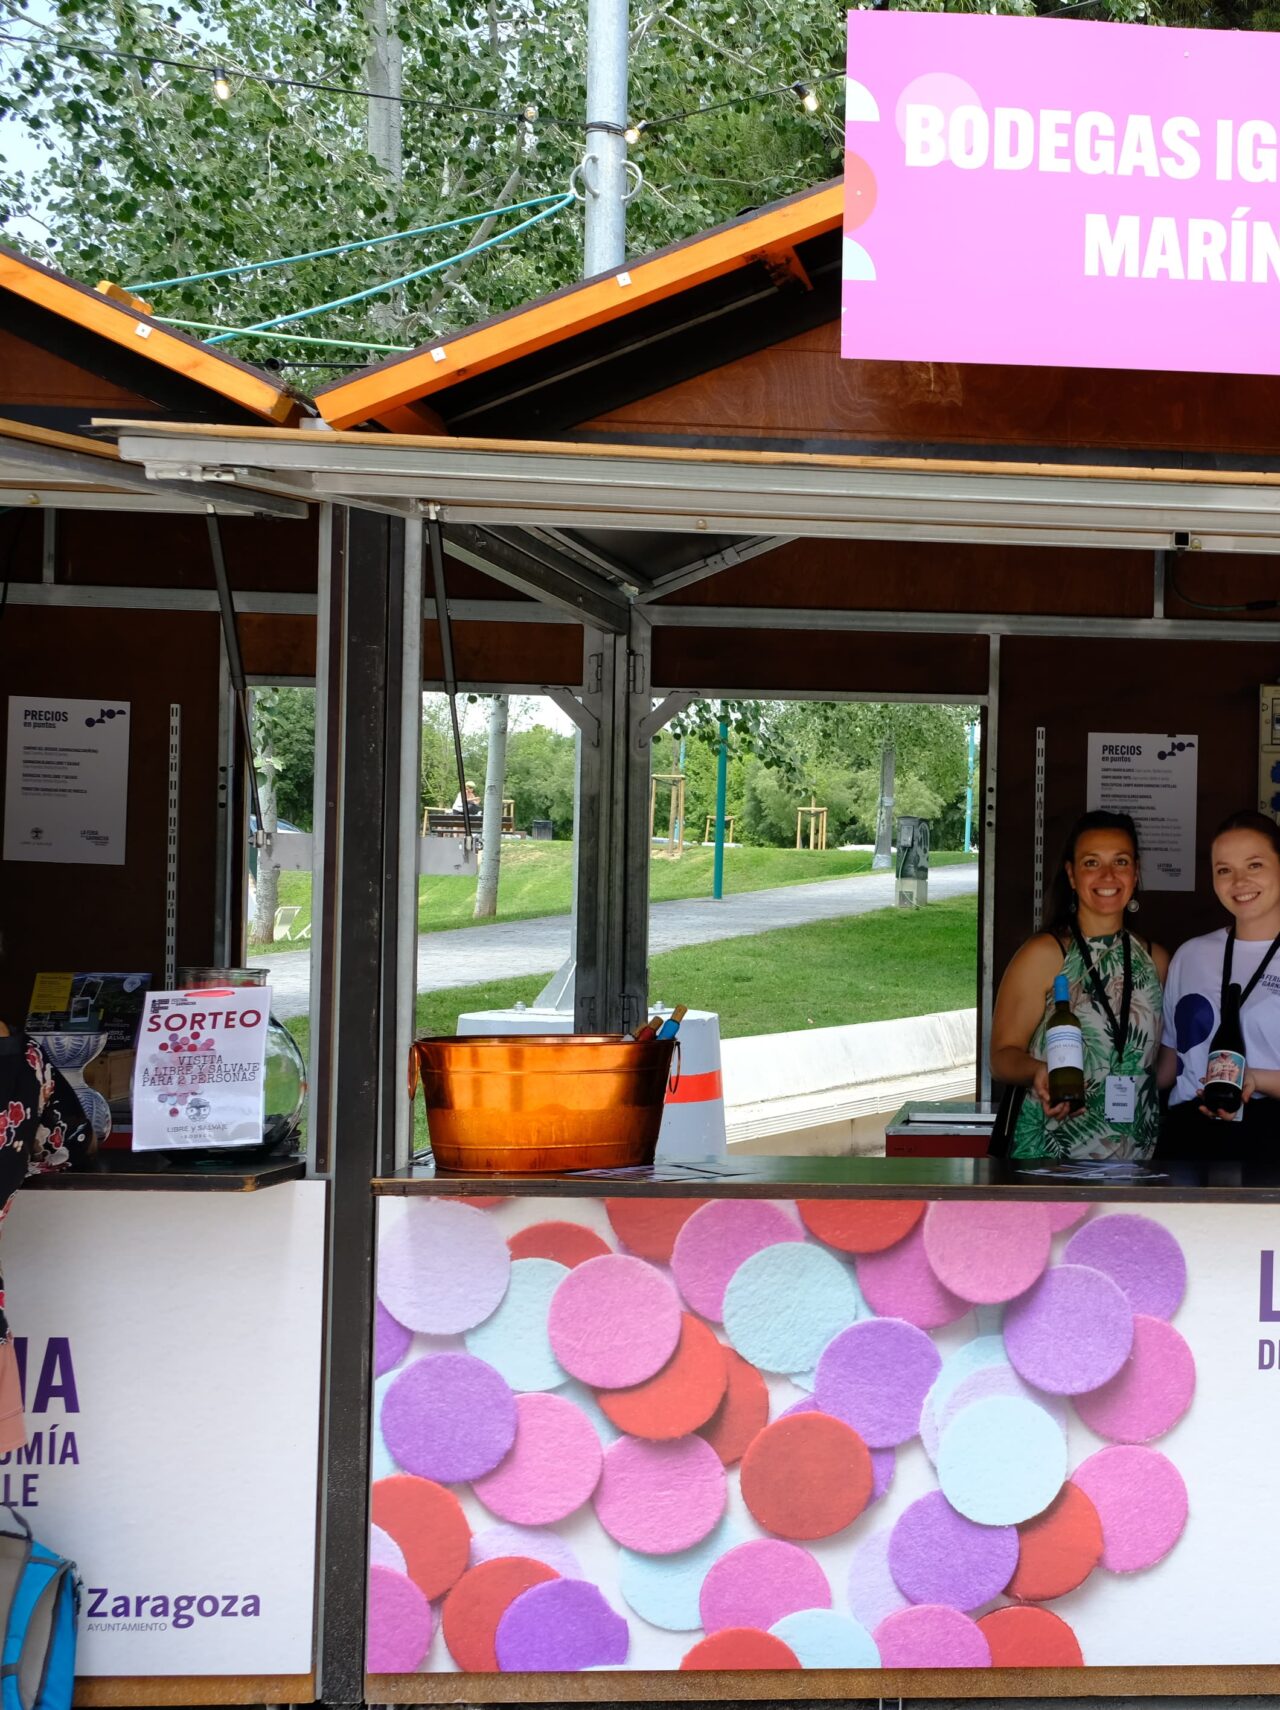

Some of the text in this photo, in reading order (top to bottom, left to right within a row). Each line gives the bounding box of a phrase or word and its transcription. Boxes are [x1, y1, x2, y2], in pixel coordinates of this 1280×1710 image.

[904, 102, 1202, 181] BODEGAS
[24, 709, 68, 722] PRECIOS
[1102, 745, 1142, 756] PRECIOS
[147, 1009, 262, 1032] SORTEO
[178, 1055, 223, 1066] VISITA
[143, 1063, 260, 1077] A LIBRE Y SALVAJE
[142, 1072, 256, 1087] PARA 2 PERSONAS
[87, 1588, 261, 1629] Zaragoza
[87, 1621, 168, 1632] AYUNTAMIENTO
